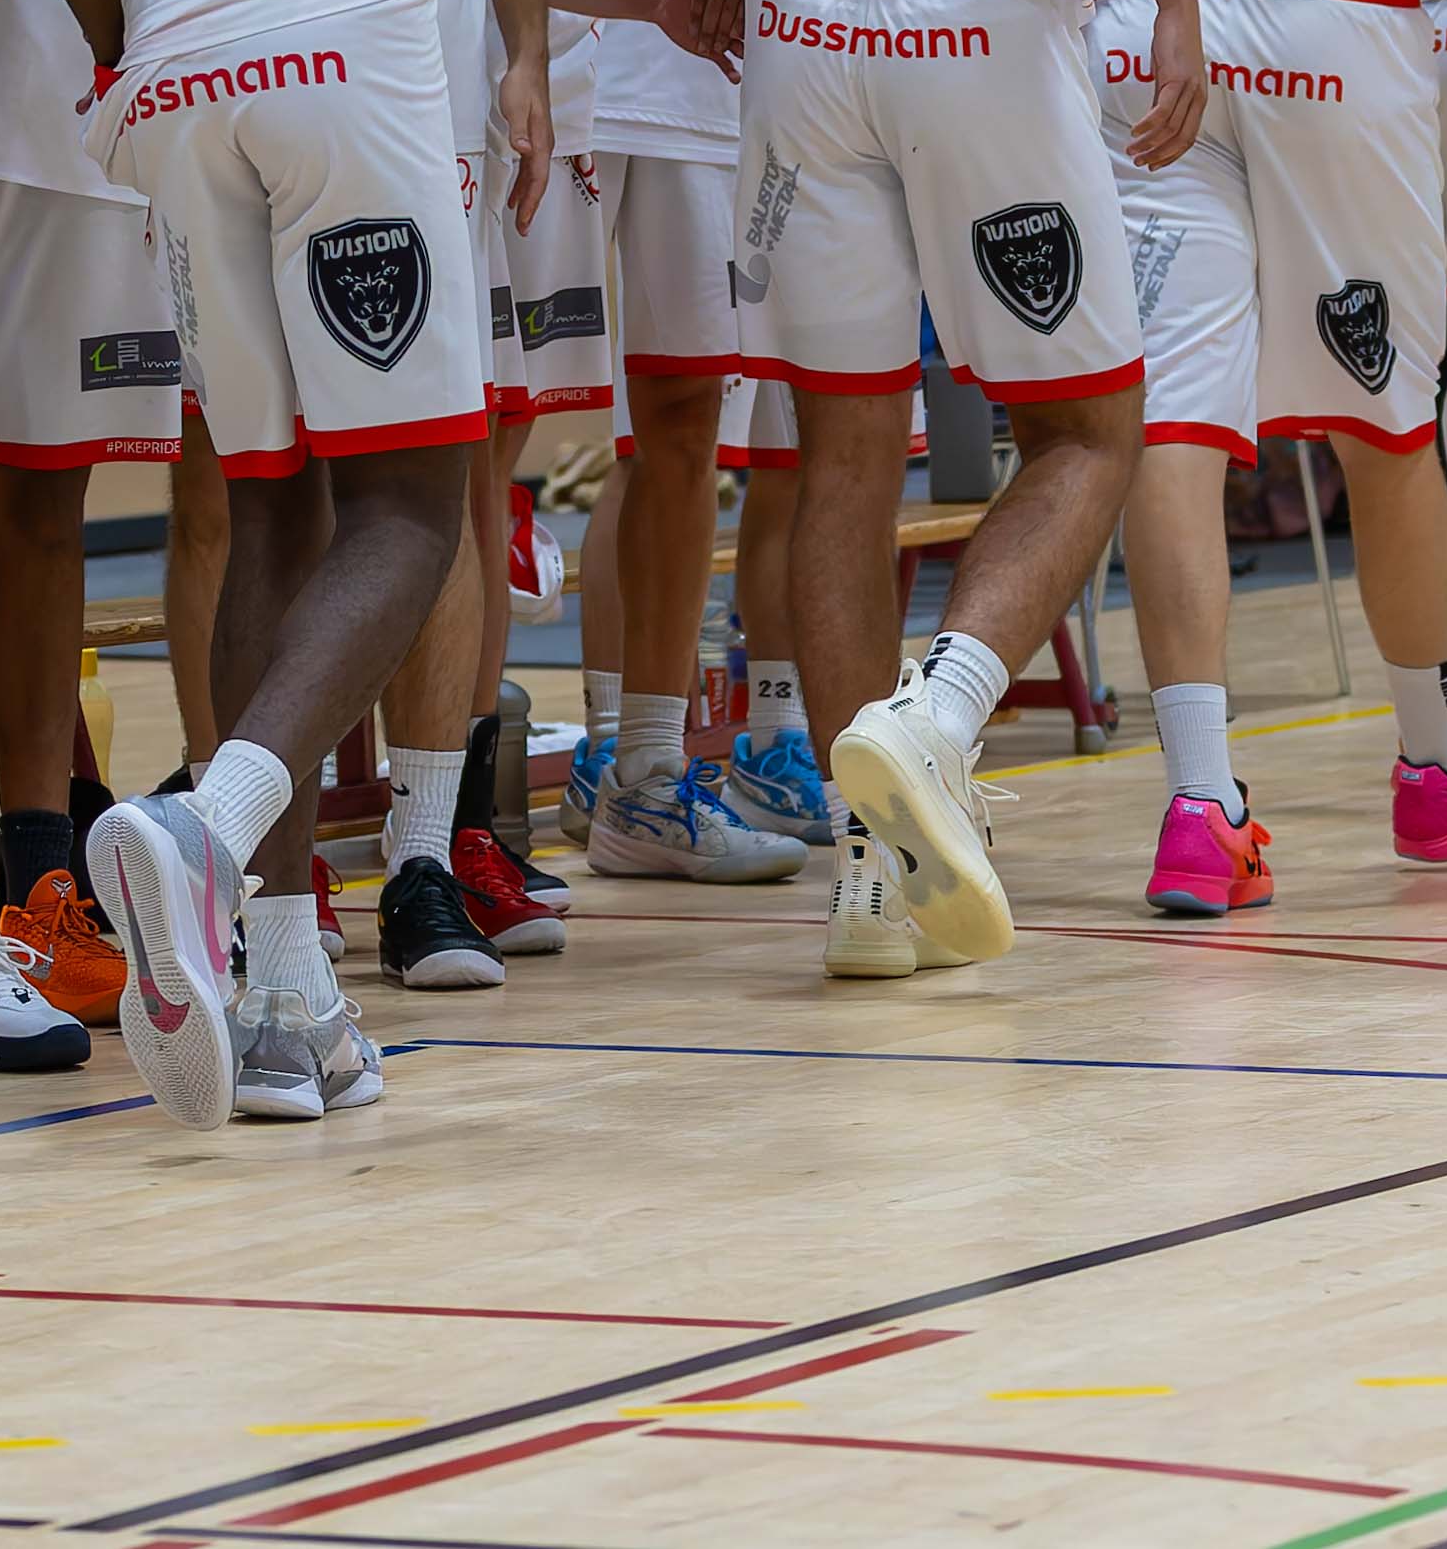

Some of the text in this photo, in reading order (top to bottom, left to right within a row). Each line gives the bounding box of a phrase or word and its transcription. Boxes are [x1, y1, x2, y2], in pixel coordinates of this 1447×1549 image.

[758, 0, 990, 59] Dussmann
[119, 50, 347, 137] ussmann
[1106, 49, 1343, 103] Dumann
[106, 439, 182, 454] #PIKEPRIDE
